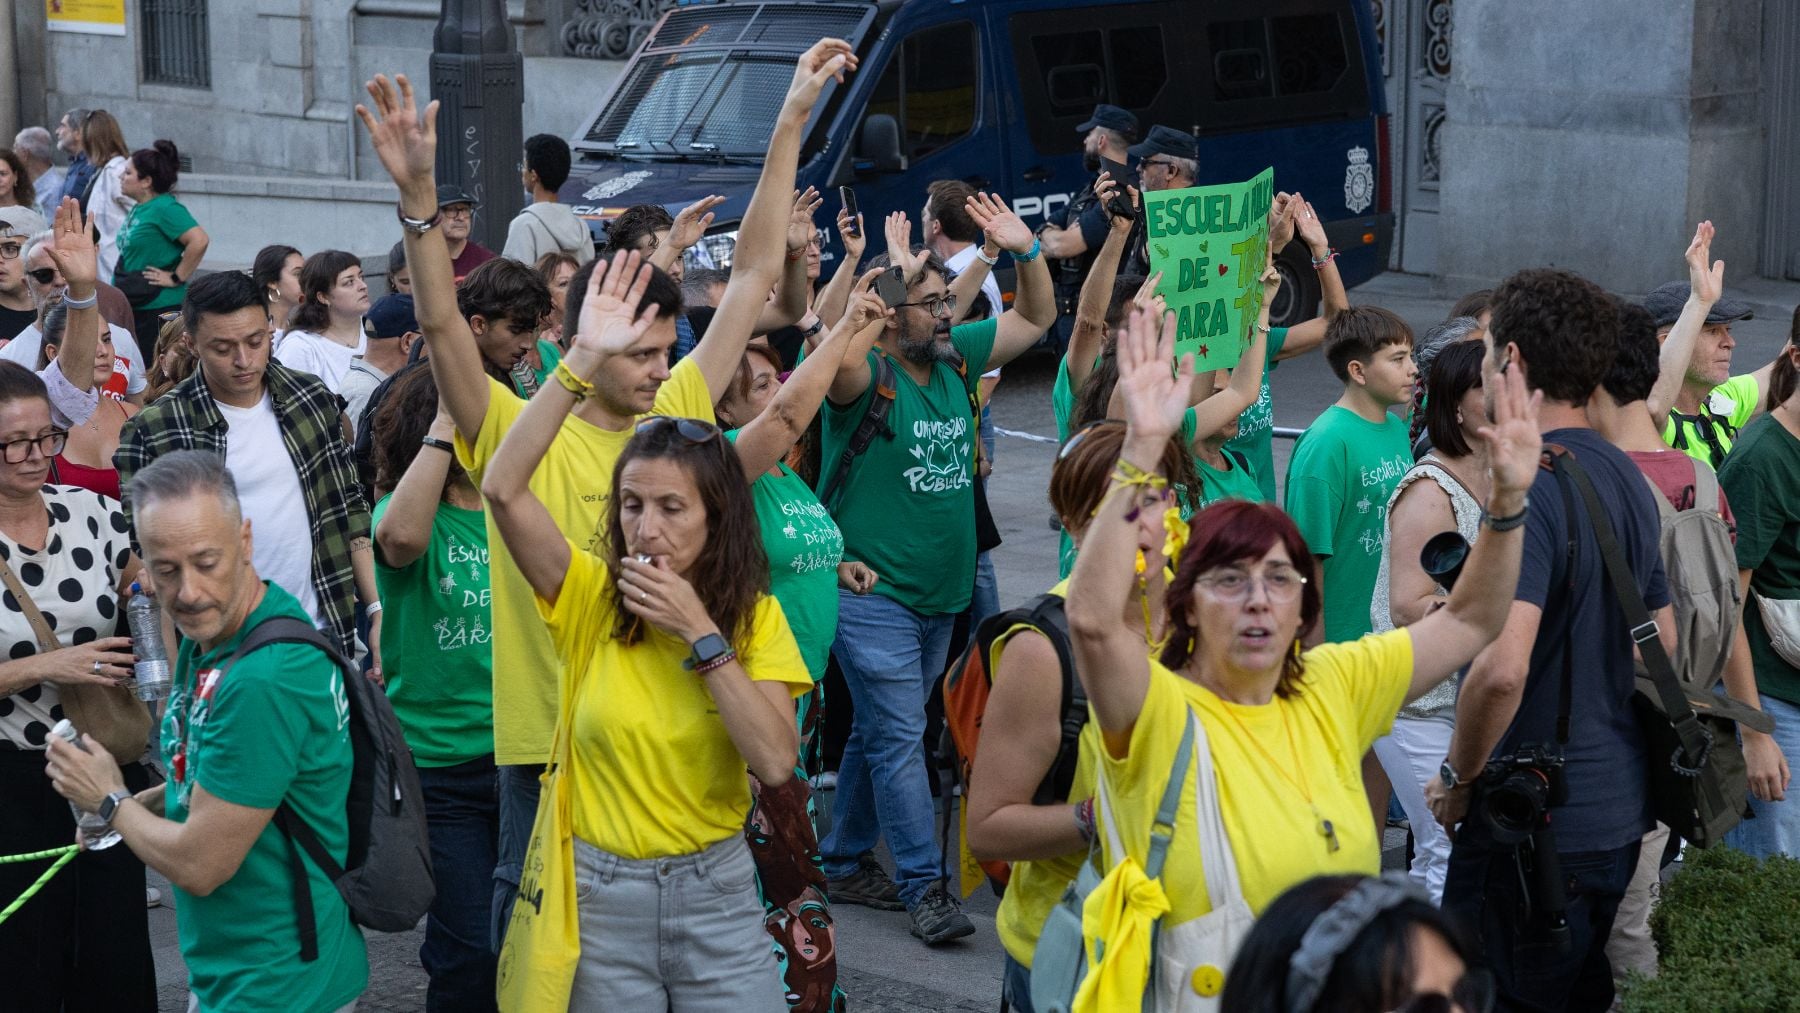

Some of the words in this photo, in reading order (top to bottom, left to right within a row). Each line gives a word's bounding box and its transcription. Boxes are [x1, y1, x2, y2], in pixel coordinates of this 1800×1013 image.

[1146, 191, 1250, 238] ESCUELA
[1177, 256, 1210, 293] DE
[902, 463, 972, 492] PÚBLICA
[463, 588, 491, 608] DE
[438, 625, 492, 647] PAR
